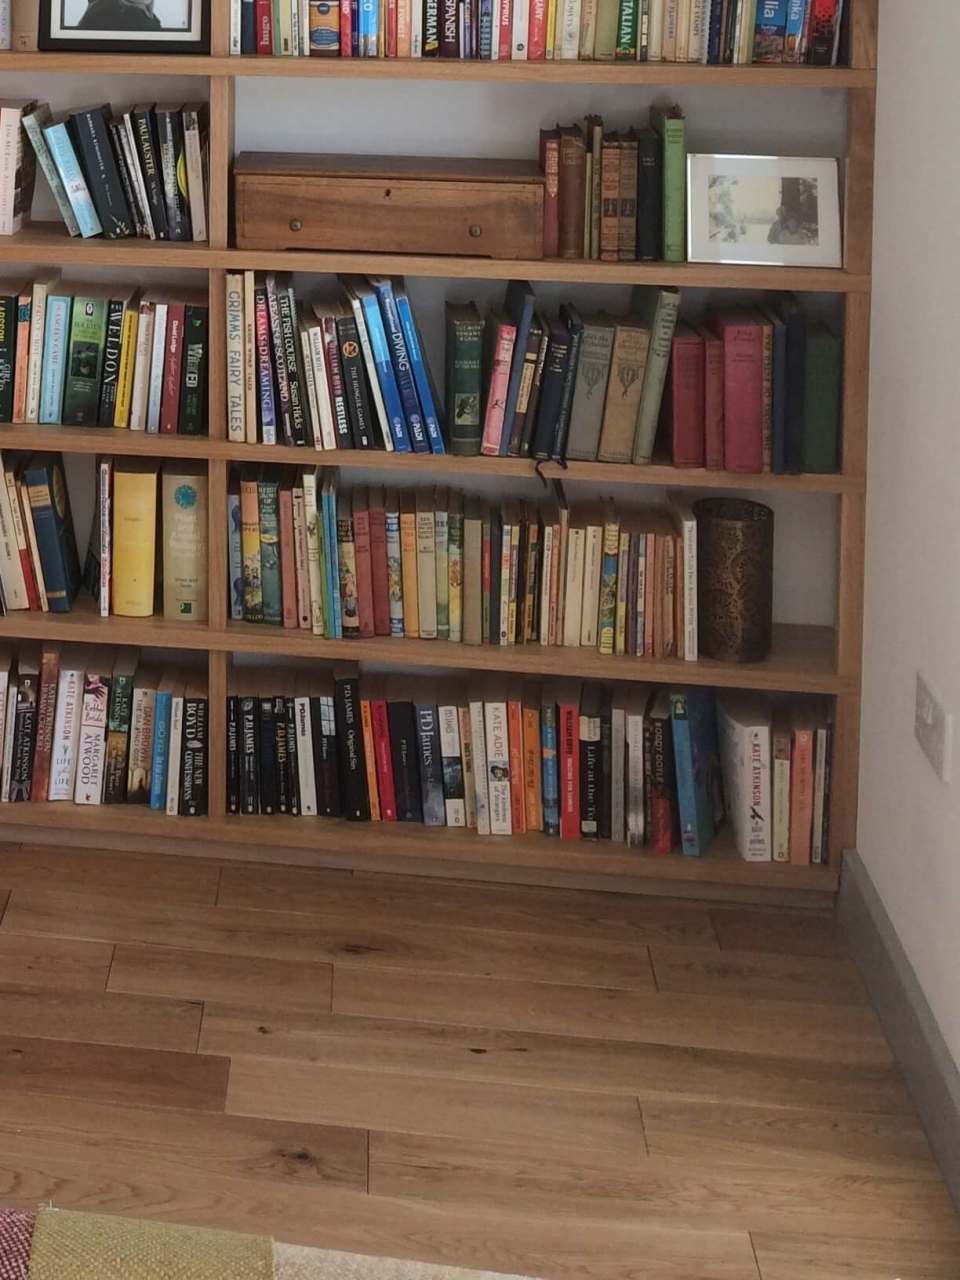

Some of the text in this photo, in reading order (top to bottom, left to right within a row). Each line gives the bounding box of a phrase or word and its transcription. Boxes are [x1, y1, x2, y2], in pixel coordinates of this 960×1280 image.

[138, 118, 155, 176] PAUL AUSTER
[104, 311, 122, 383] WELDON
[185, 343, 203, 387] WICKED
[229, 290, 242, 432] GRIMMS FAIRY TALES
[256, 295, 272, 408] DREAMS DREAMING
[269, 293, 289, 402] A FEAST SCOTLAND
[280, 297, 303, 429] THE FISH COURSE Susan Hicks
[391, 332, 409, 371] DIVING
[350, 366, 358, 379] THE
[356, 407, 366, 430] GAMES
[394, 423, 403, 439] PADI
[413, 423, 423, 441] PADI
[62, 680, 76, 746] KATE ATKINSON
[185, 703, 197, 738] BOYD
[196, 703, 205, 739] WILLIAM
[493, 706, 503, 759] KATE ADIE
[22, 712, 33, 780] KATE ATKINSON
[81, 739, 93, 790] ATWOOD
[90, 738, 101, 790] MARGARET
[347, 729, 356, 757] Original
[587, 746, 596, 770] Life
[184, 751, 194, 800] CONFESSIONS
[194, 752, 203, 790] THE NEW
[587, 773, 595, 782] at
[587, 784, 596, 800] the
[751, 743, 762, 807] KATE ATKINSON
